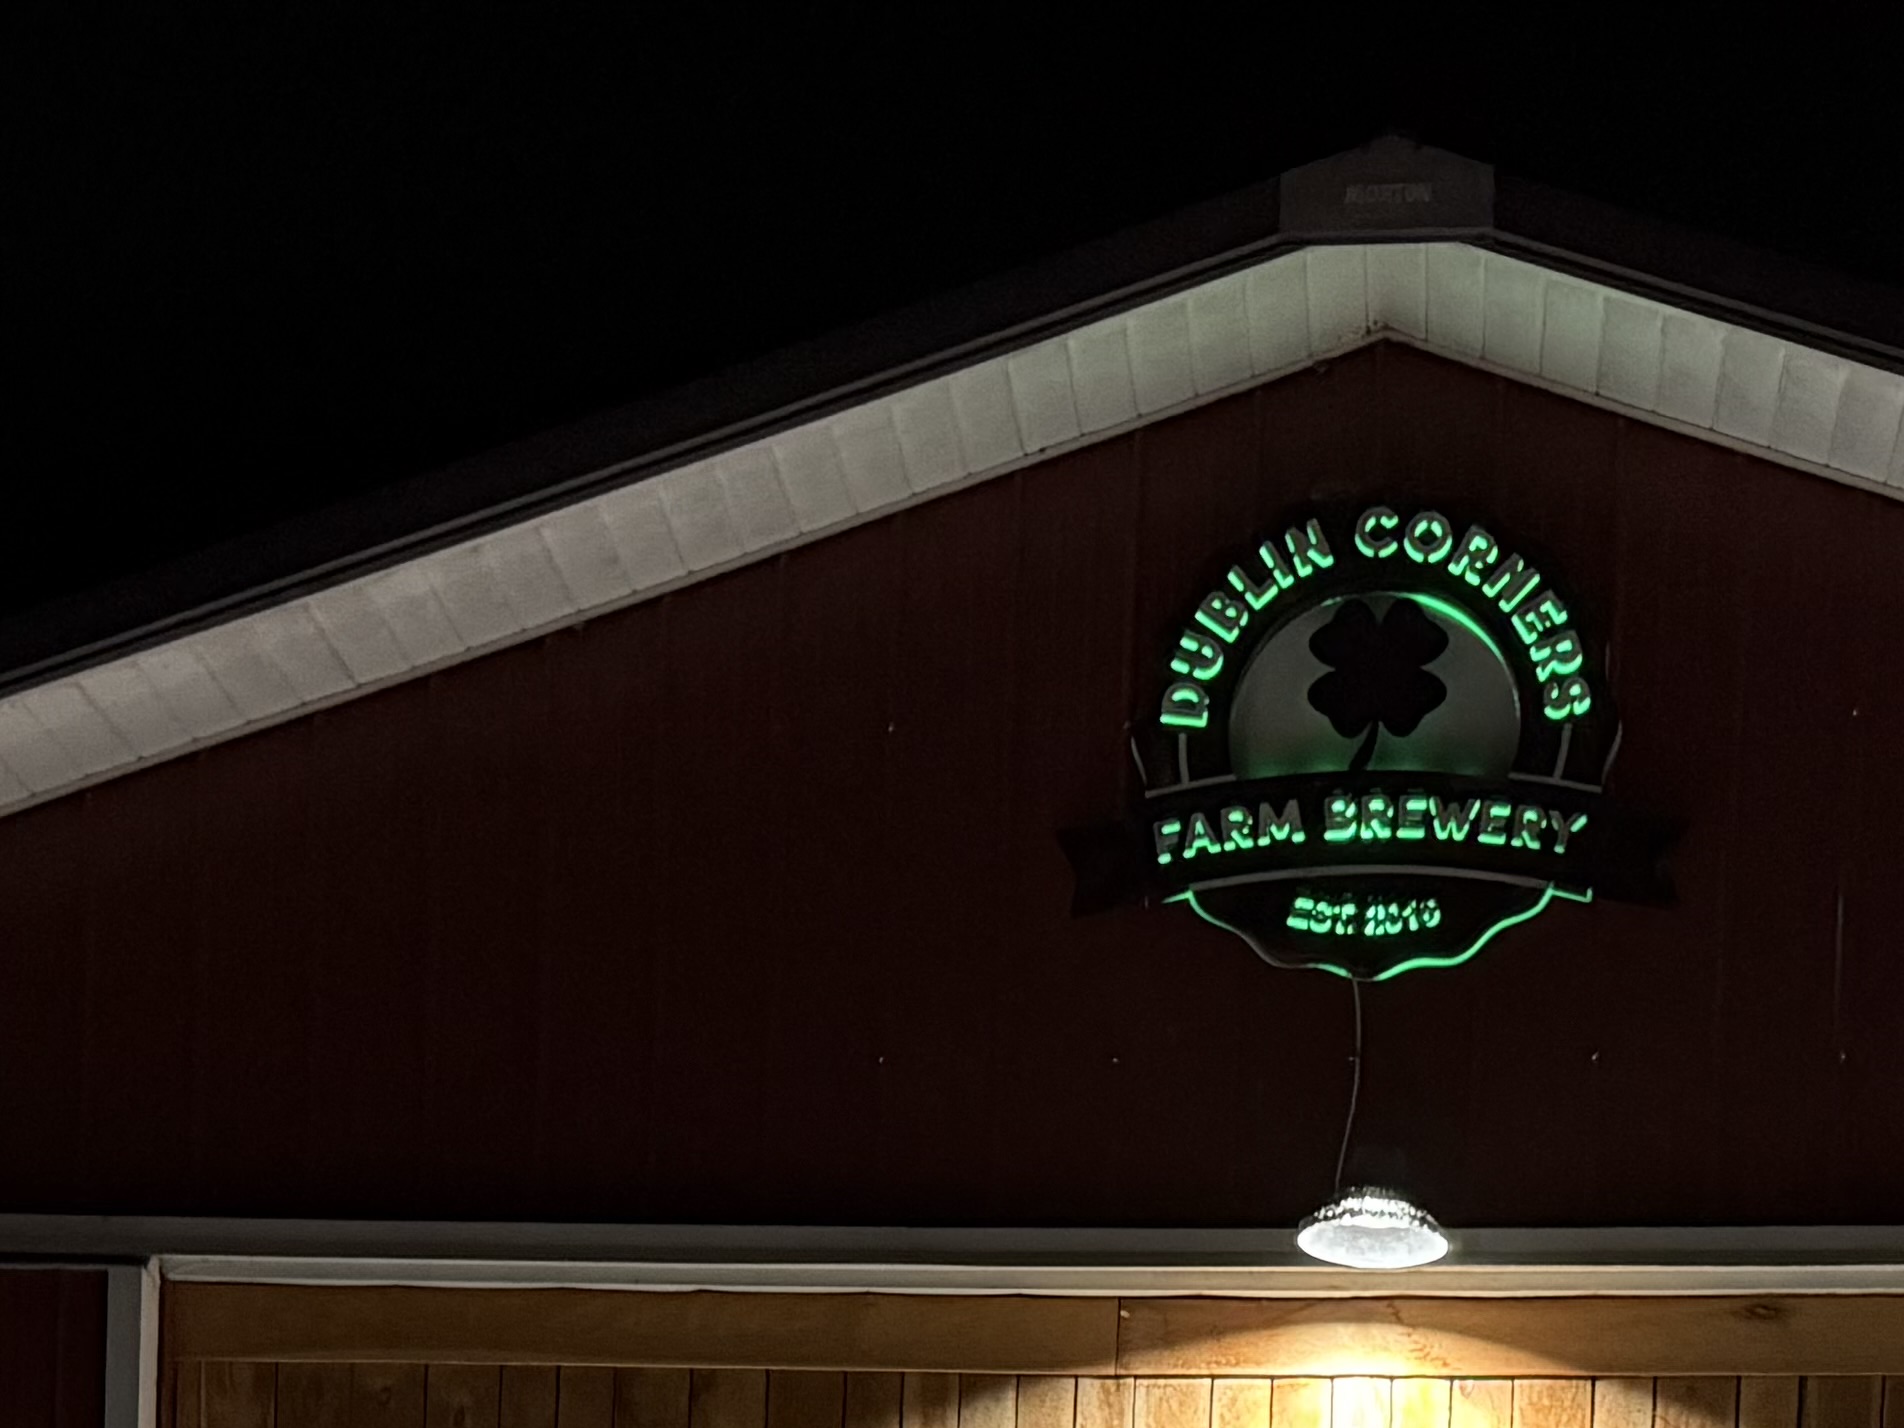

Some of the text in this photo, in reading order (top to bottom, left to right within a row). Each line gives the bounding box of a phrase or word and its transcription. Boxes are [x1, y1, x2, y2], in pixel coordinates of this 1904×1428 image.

[1160, 506, 1592, 728] DUBLIN CORNERS
[1153, 793, 1588, 864] FARM BREWERY
